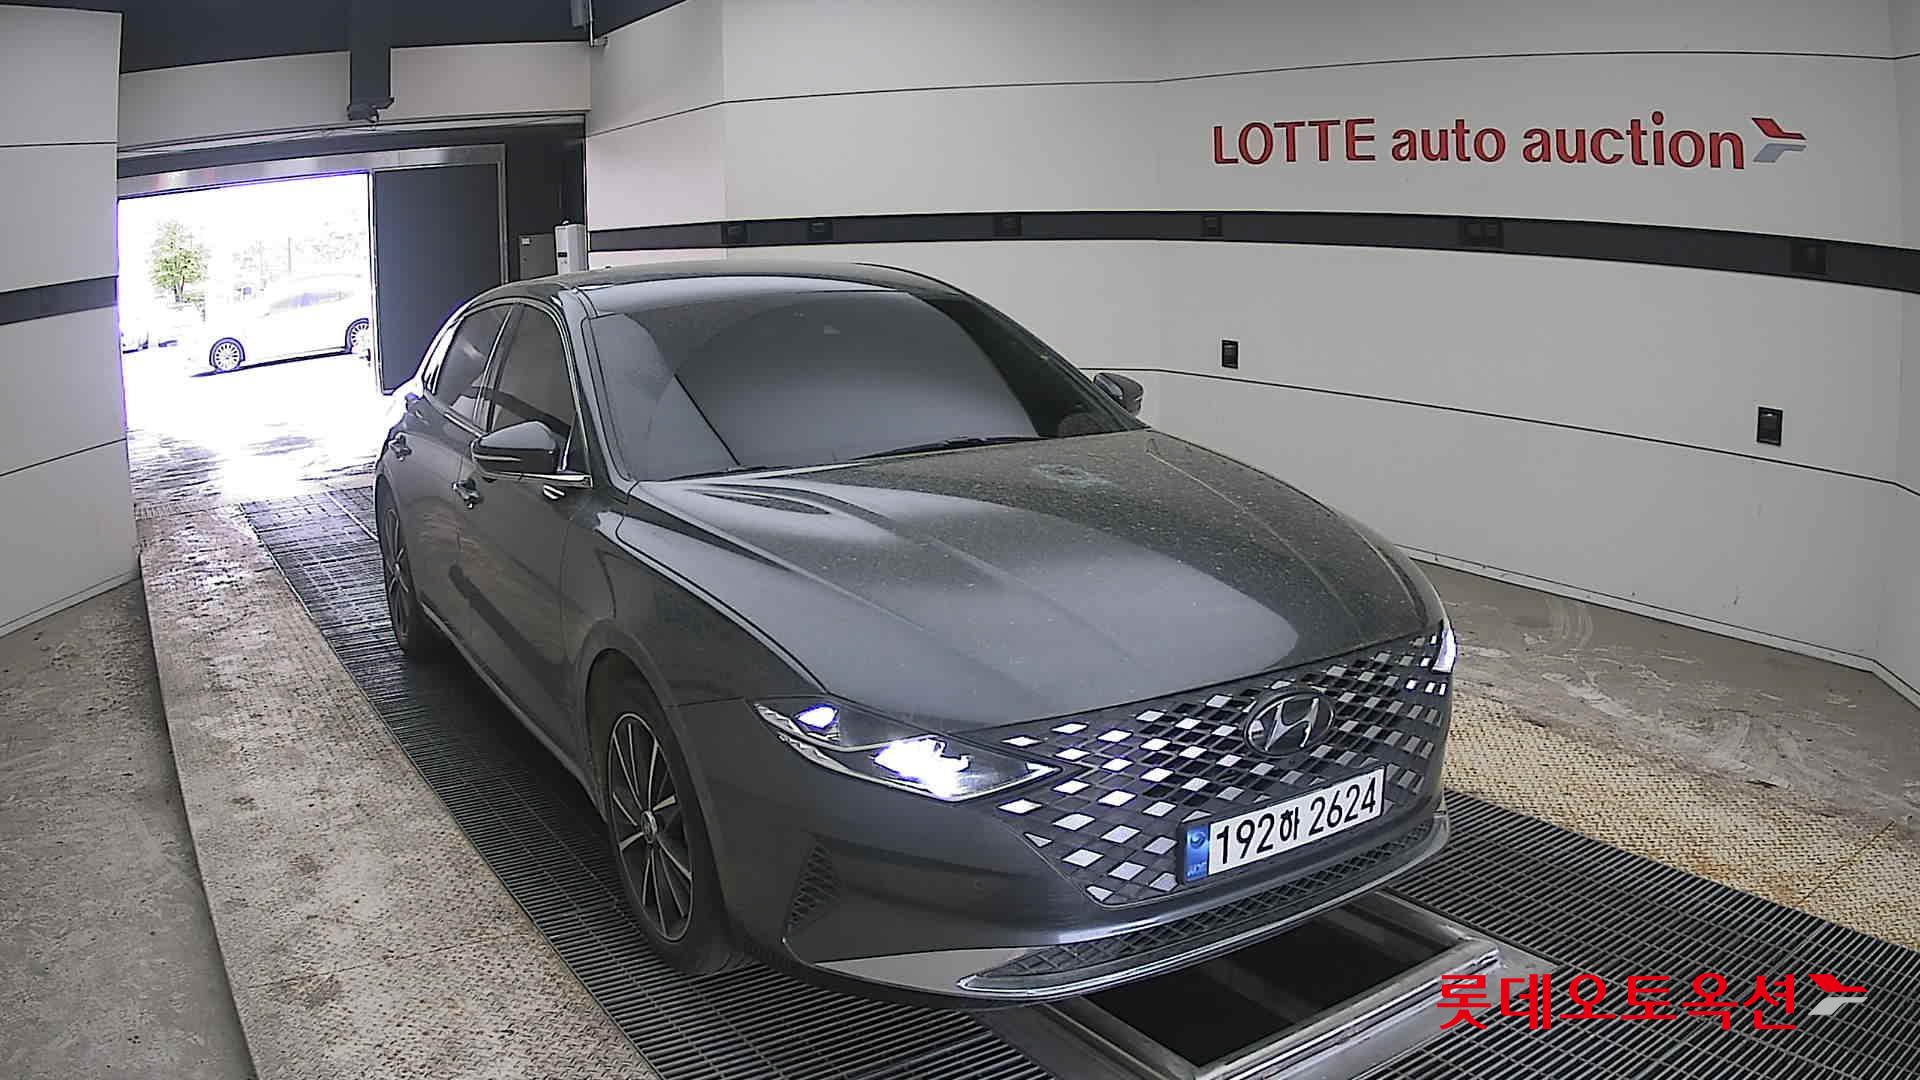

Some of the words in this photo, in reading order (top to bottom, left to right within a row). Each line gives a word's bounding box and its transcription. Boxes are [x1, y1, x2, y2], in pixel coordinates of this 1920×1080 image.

[1212, 117, 1376, 165] LOTTE
[1391, 118, 1507, 163] auto
[1522, 110, 1745, 170] auction
[1216, 806, 1300, 865] 192하
[1308, 777, 1377, 837] 2624
